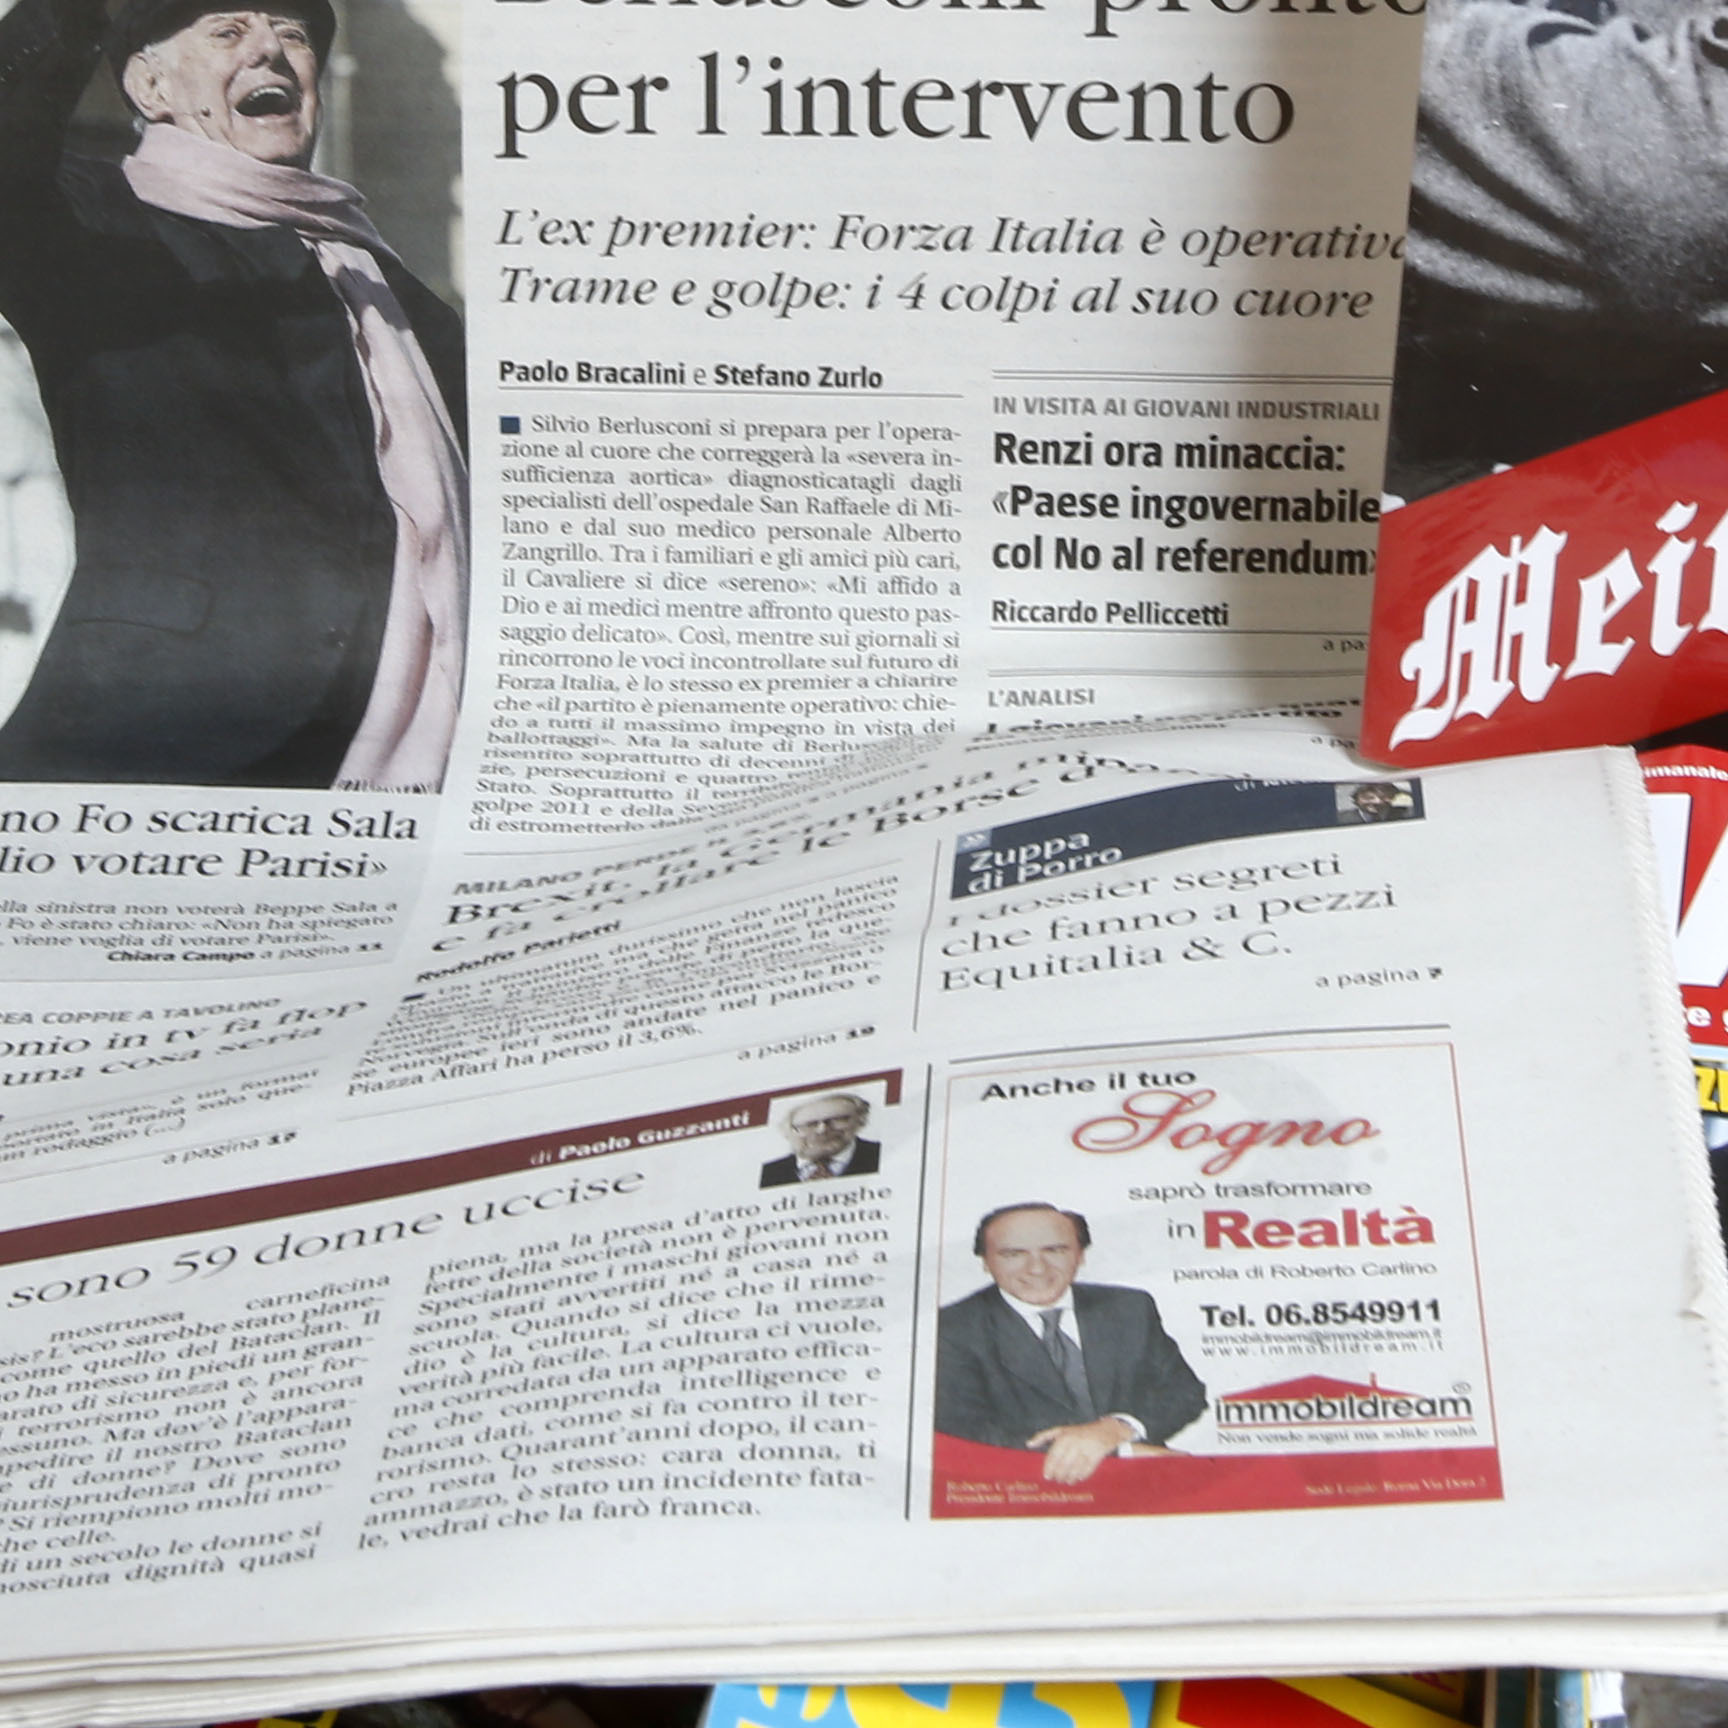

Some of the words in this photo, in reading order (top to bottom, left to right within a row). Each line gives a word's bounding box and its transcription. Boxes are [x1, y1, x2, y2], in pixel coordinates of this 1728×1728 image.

[494, 68, 670, 160] per
[700, 49, 1296, 146] l'intervento
[993, 431, 1093, 467] Renzi
[1103, 440, 1163, 469] ora
[1174, 434, 1347, 472] minaccia:
[1070, 1088, 1382, 1177] Sogno
[5, 1260, 151, 1311] sono
[162, 1242, 238, 1286] 59
[253, 1208, 446, 1270] donne
[459, 1168, 648, 1224] uccise
[1166, 1217, 1197, 1242] in
[1202, 1204, 1438, 1250] Realtà
[1199, 1303, 1257, 1329] Tel.
[1264, 1298, 1443, 1328] 06.8549911
[1215, 1395, 1473, 1424] immobildream
